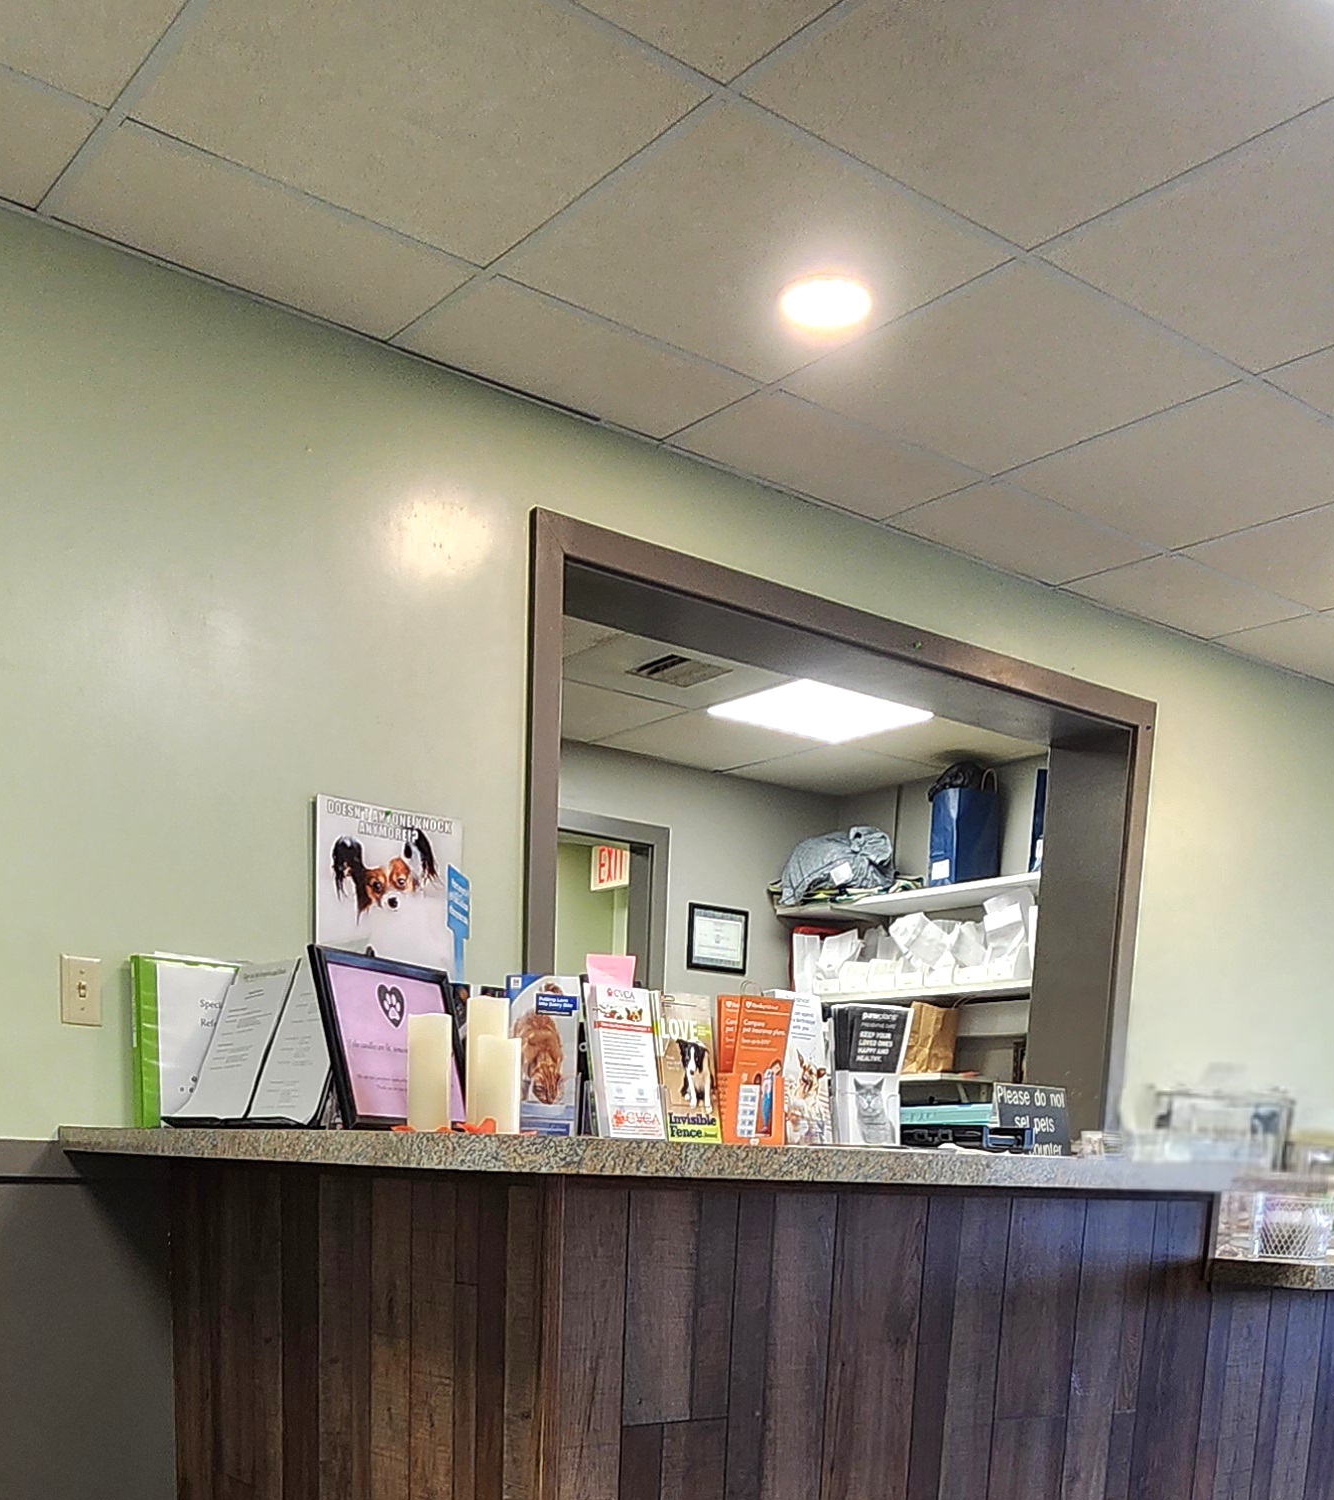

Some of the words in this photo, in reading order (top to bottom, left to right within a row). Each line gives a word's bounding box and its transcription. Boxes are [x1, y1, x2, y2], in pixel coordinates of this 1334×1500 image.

[327, 799, 370, 820] DOESN'T
[371, 808, 413, 829] ANYONE
[413, 814, 453, 834] KNOCK
[613, 987, 636, 999] CVCA
[660, 1017, 699, 1041] LOVE
[996, 1085, 1031, 1106] Please
[1034, 1088, 1047, 1107] do
[1049, 1092, 1066, 1108] not
[668, 1112, 716, 1126] Invisible
[1033, 1116, 1055, 1134] pets
[670, 1126, 703, 1139] Fence
